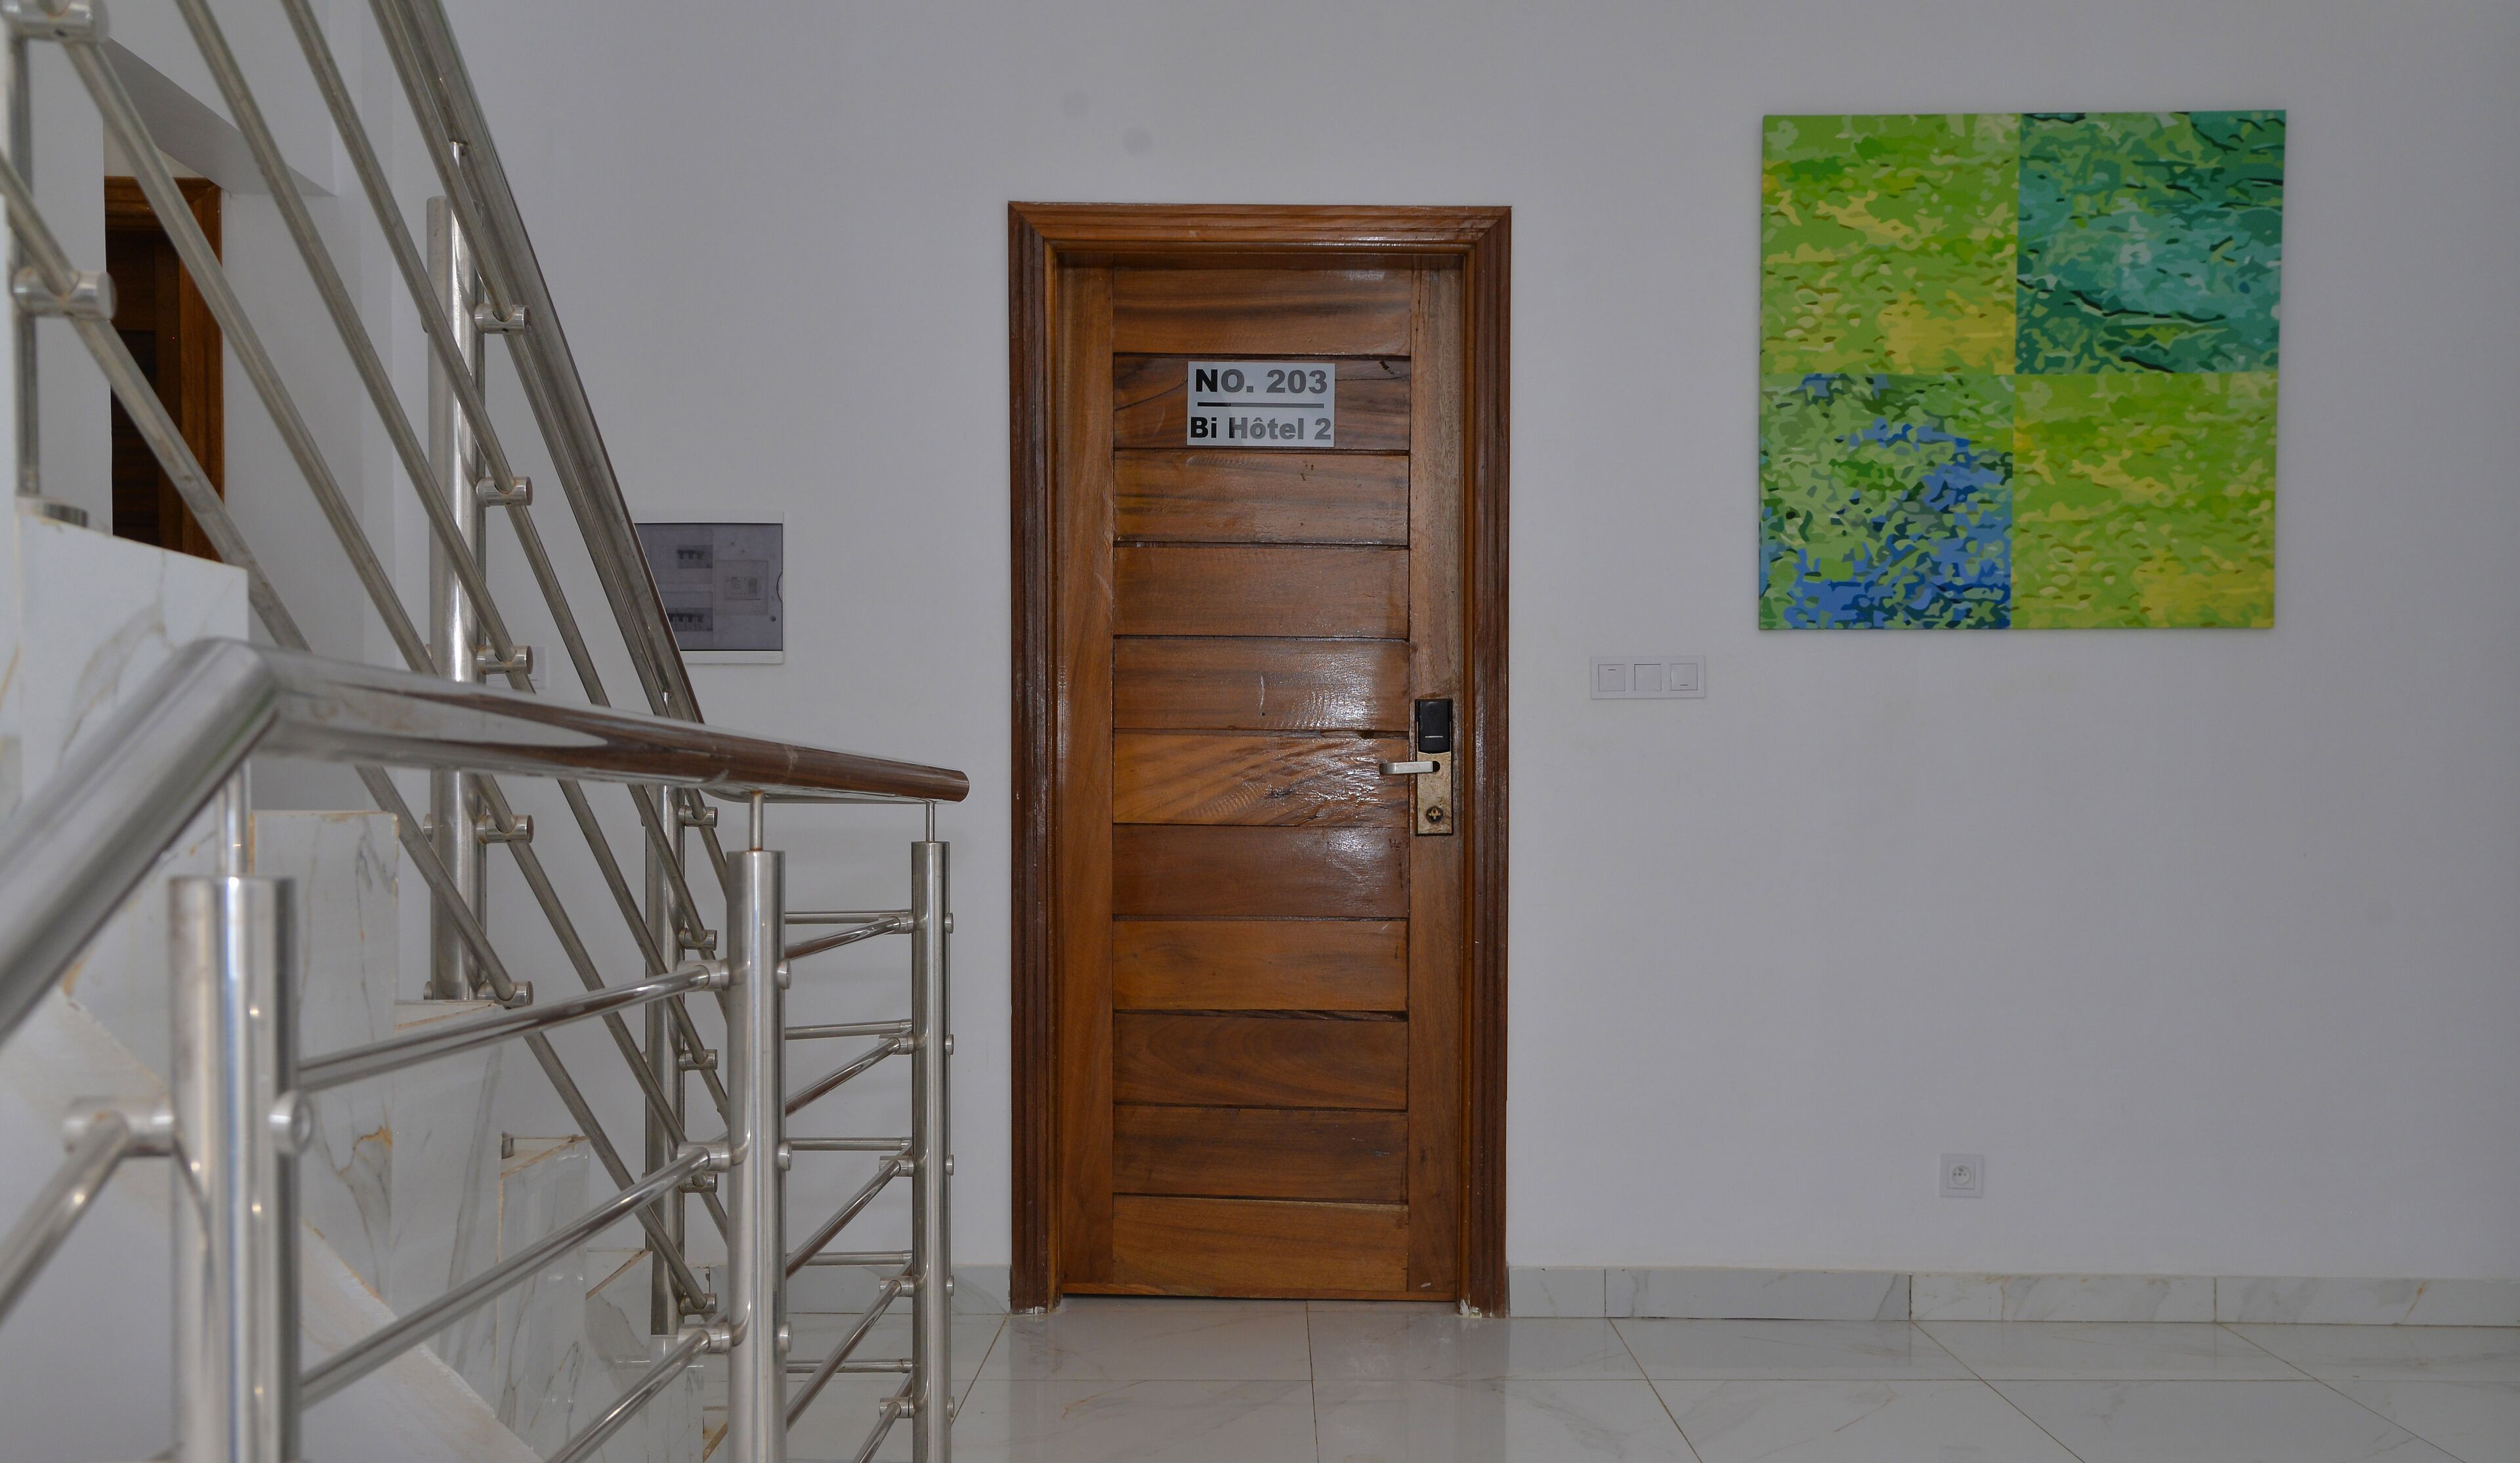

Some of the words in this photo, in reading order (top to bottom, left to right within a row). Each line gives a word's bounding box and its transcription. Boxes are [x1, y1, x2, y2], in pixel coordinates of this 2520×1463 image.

[1196, 369, 1254, 393] NO.
[1266, 369, 1328, 394] 203
[1190, 417, 1217, 438] Bi
[1228, 417, 1304, 440] Hôtel
[1314, 418, 1331, 440] 2
